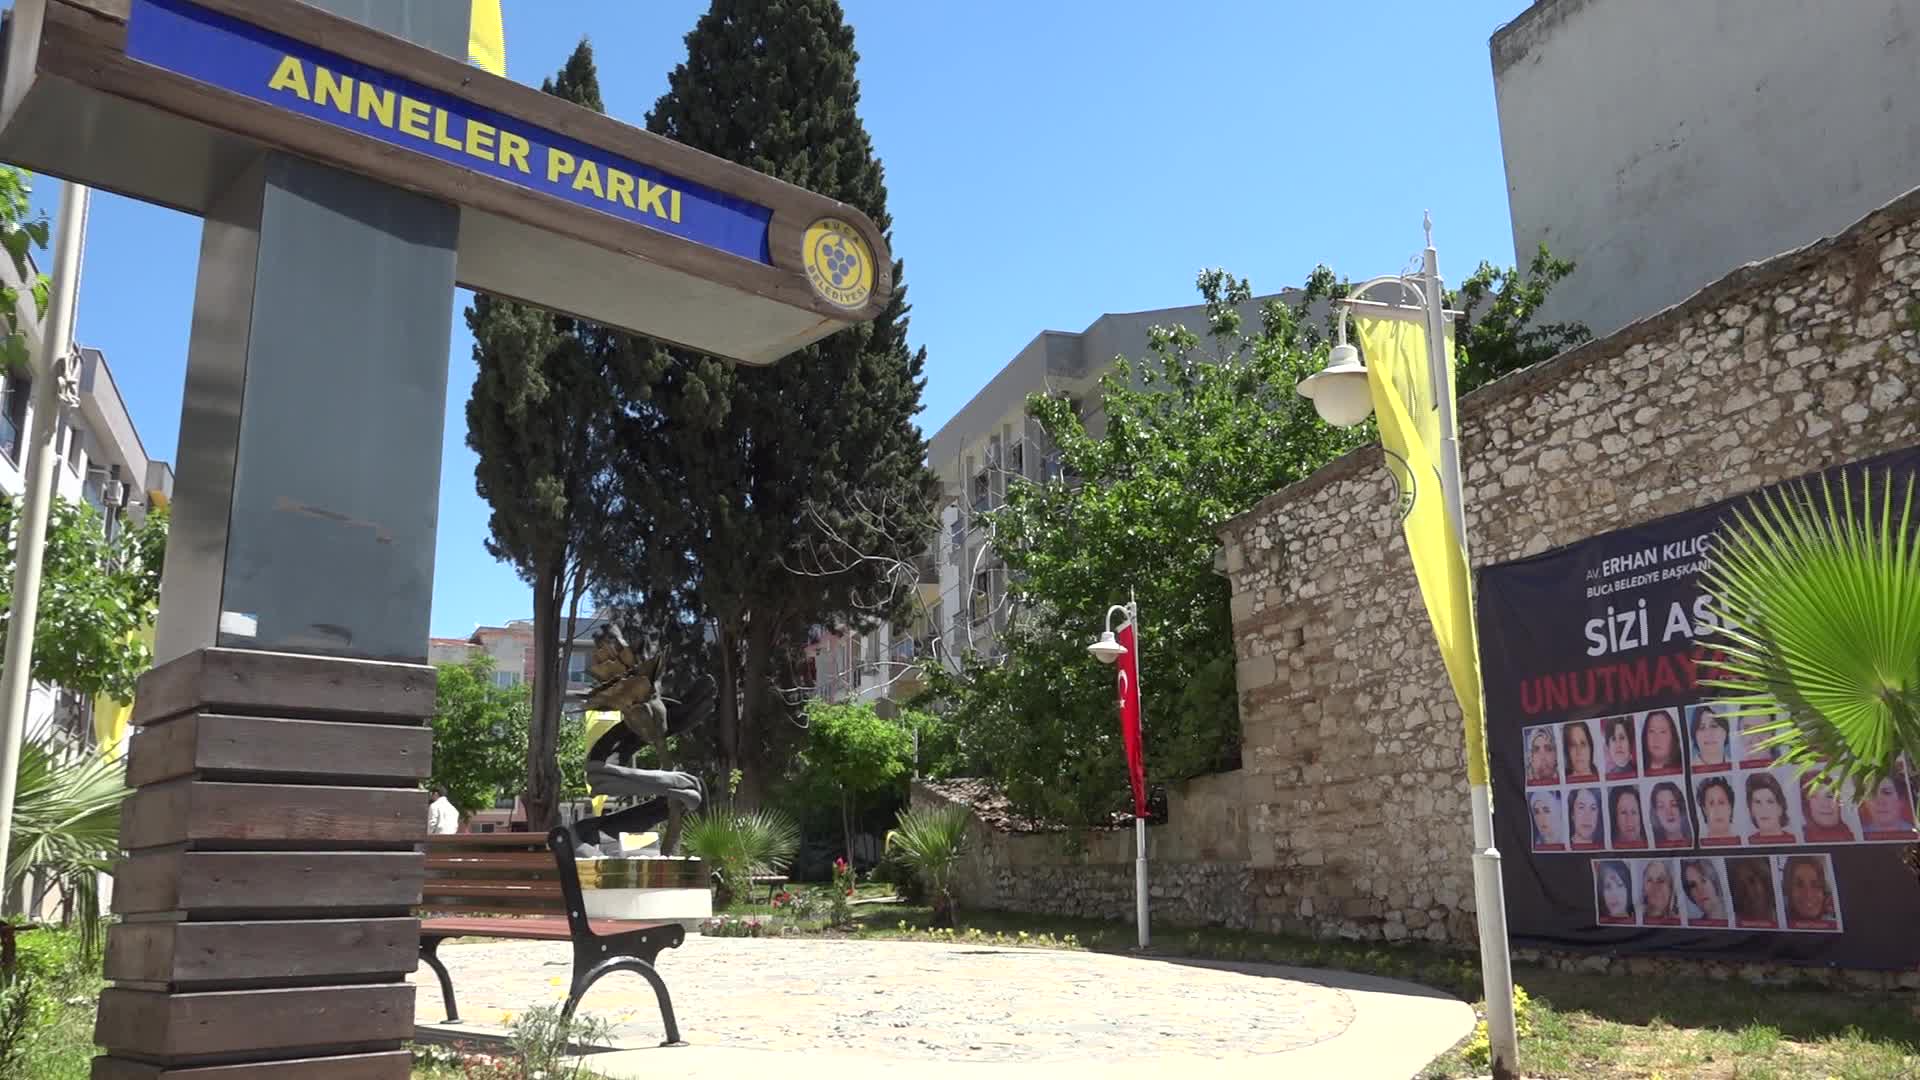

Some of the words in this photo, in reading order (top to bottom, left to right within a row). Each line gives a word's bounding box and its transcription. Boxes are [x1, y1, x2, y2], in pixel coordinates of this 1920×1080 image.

[268, 55, 531, 173] ANNELER
[547, 147, 681, 224] PARKI
[1602, 547, 1657, 577] ERHAN
[1663, 534, 1709, 561] KILIÇ
[1586, 581, 1613, 598] BUCA
[1585, 598, 1649, 657] SİZİ
